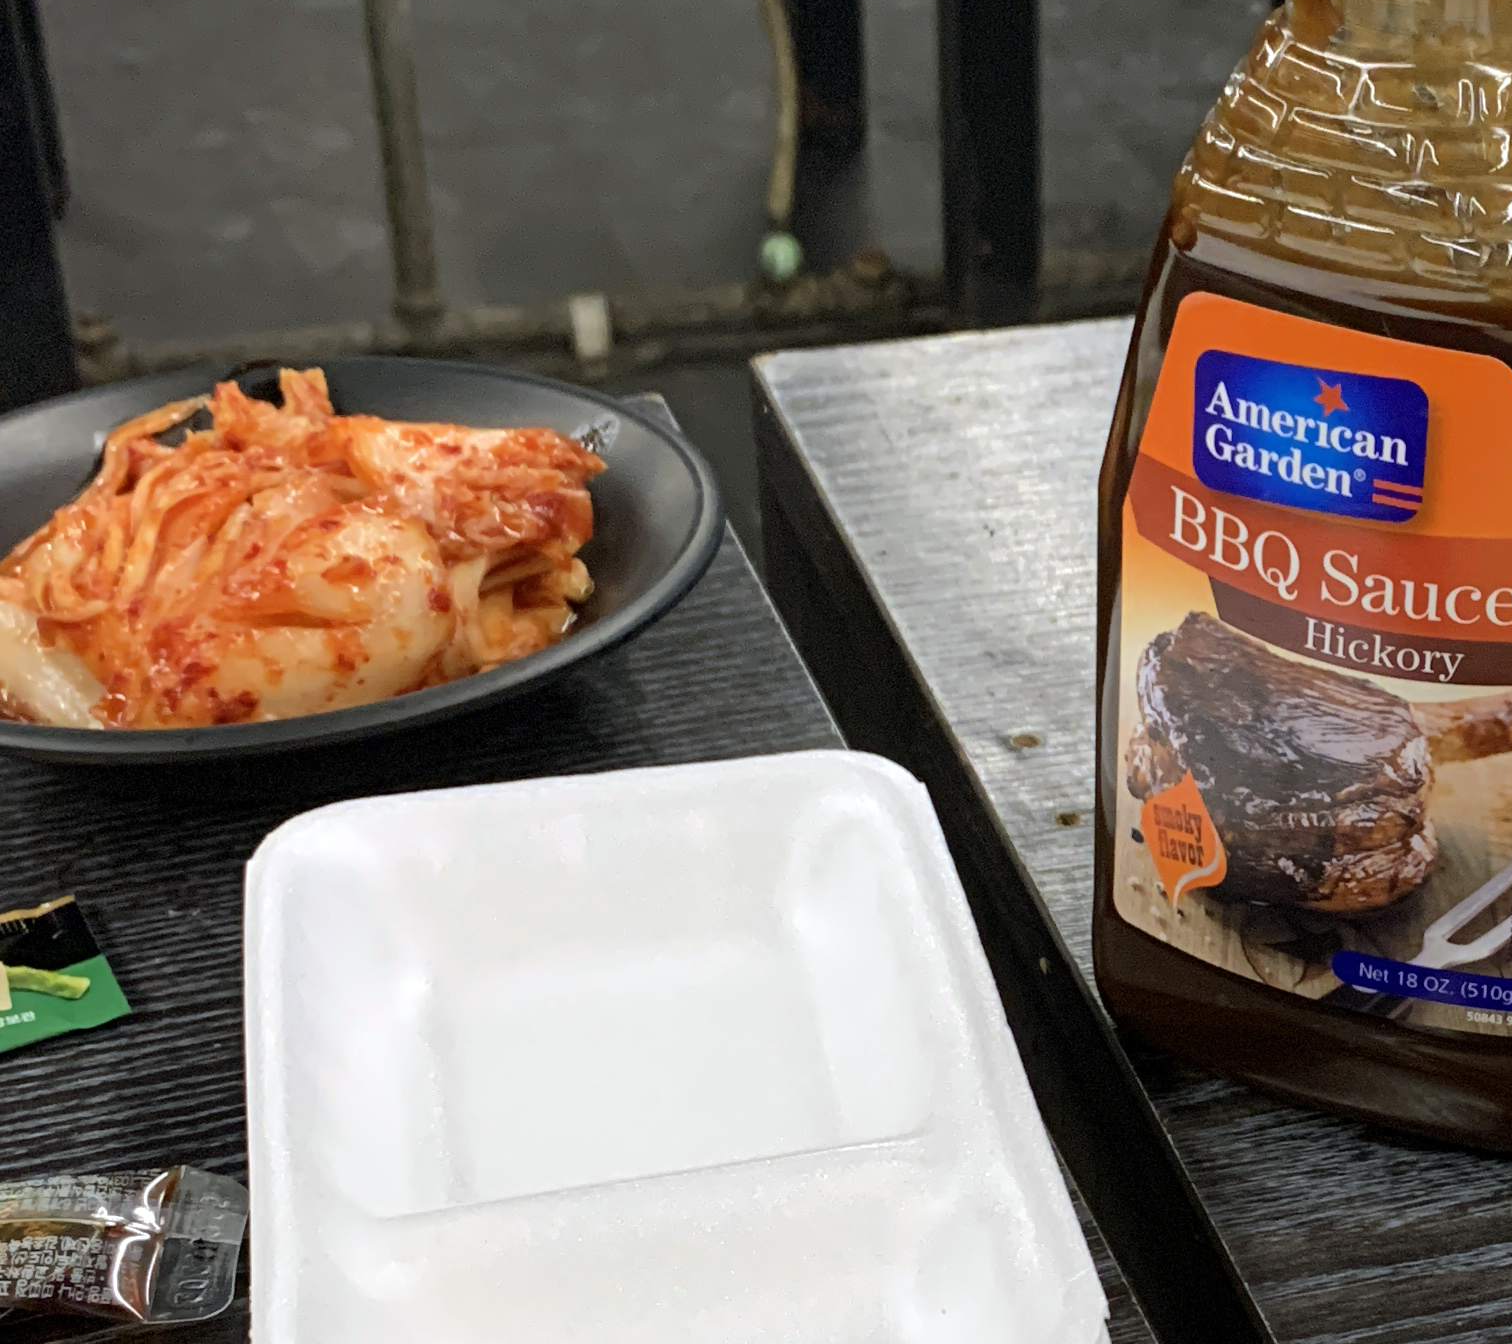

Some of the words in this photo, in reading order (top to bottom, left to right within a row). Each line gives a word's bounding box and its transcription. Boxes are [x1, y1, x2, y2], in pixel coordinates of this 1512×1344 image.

[1205, 381, 1409, 467] American
[1168, 485, 1301, 602] BBQ
[1303, 616, 1465, 681] Hickory
[1153, 803, 1203, 844] smoky
[1158, 828, 1205, 868] flavor
[1358, 961, 1390, 984] Net
[1398, 970, 1418, 989] 18
